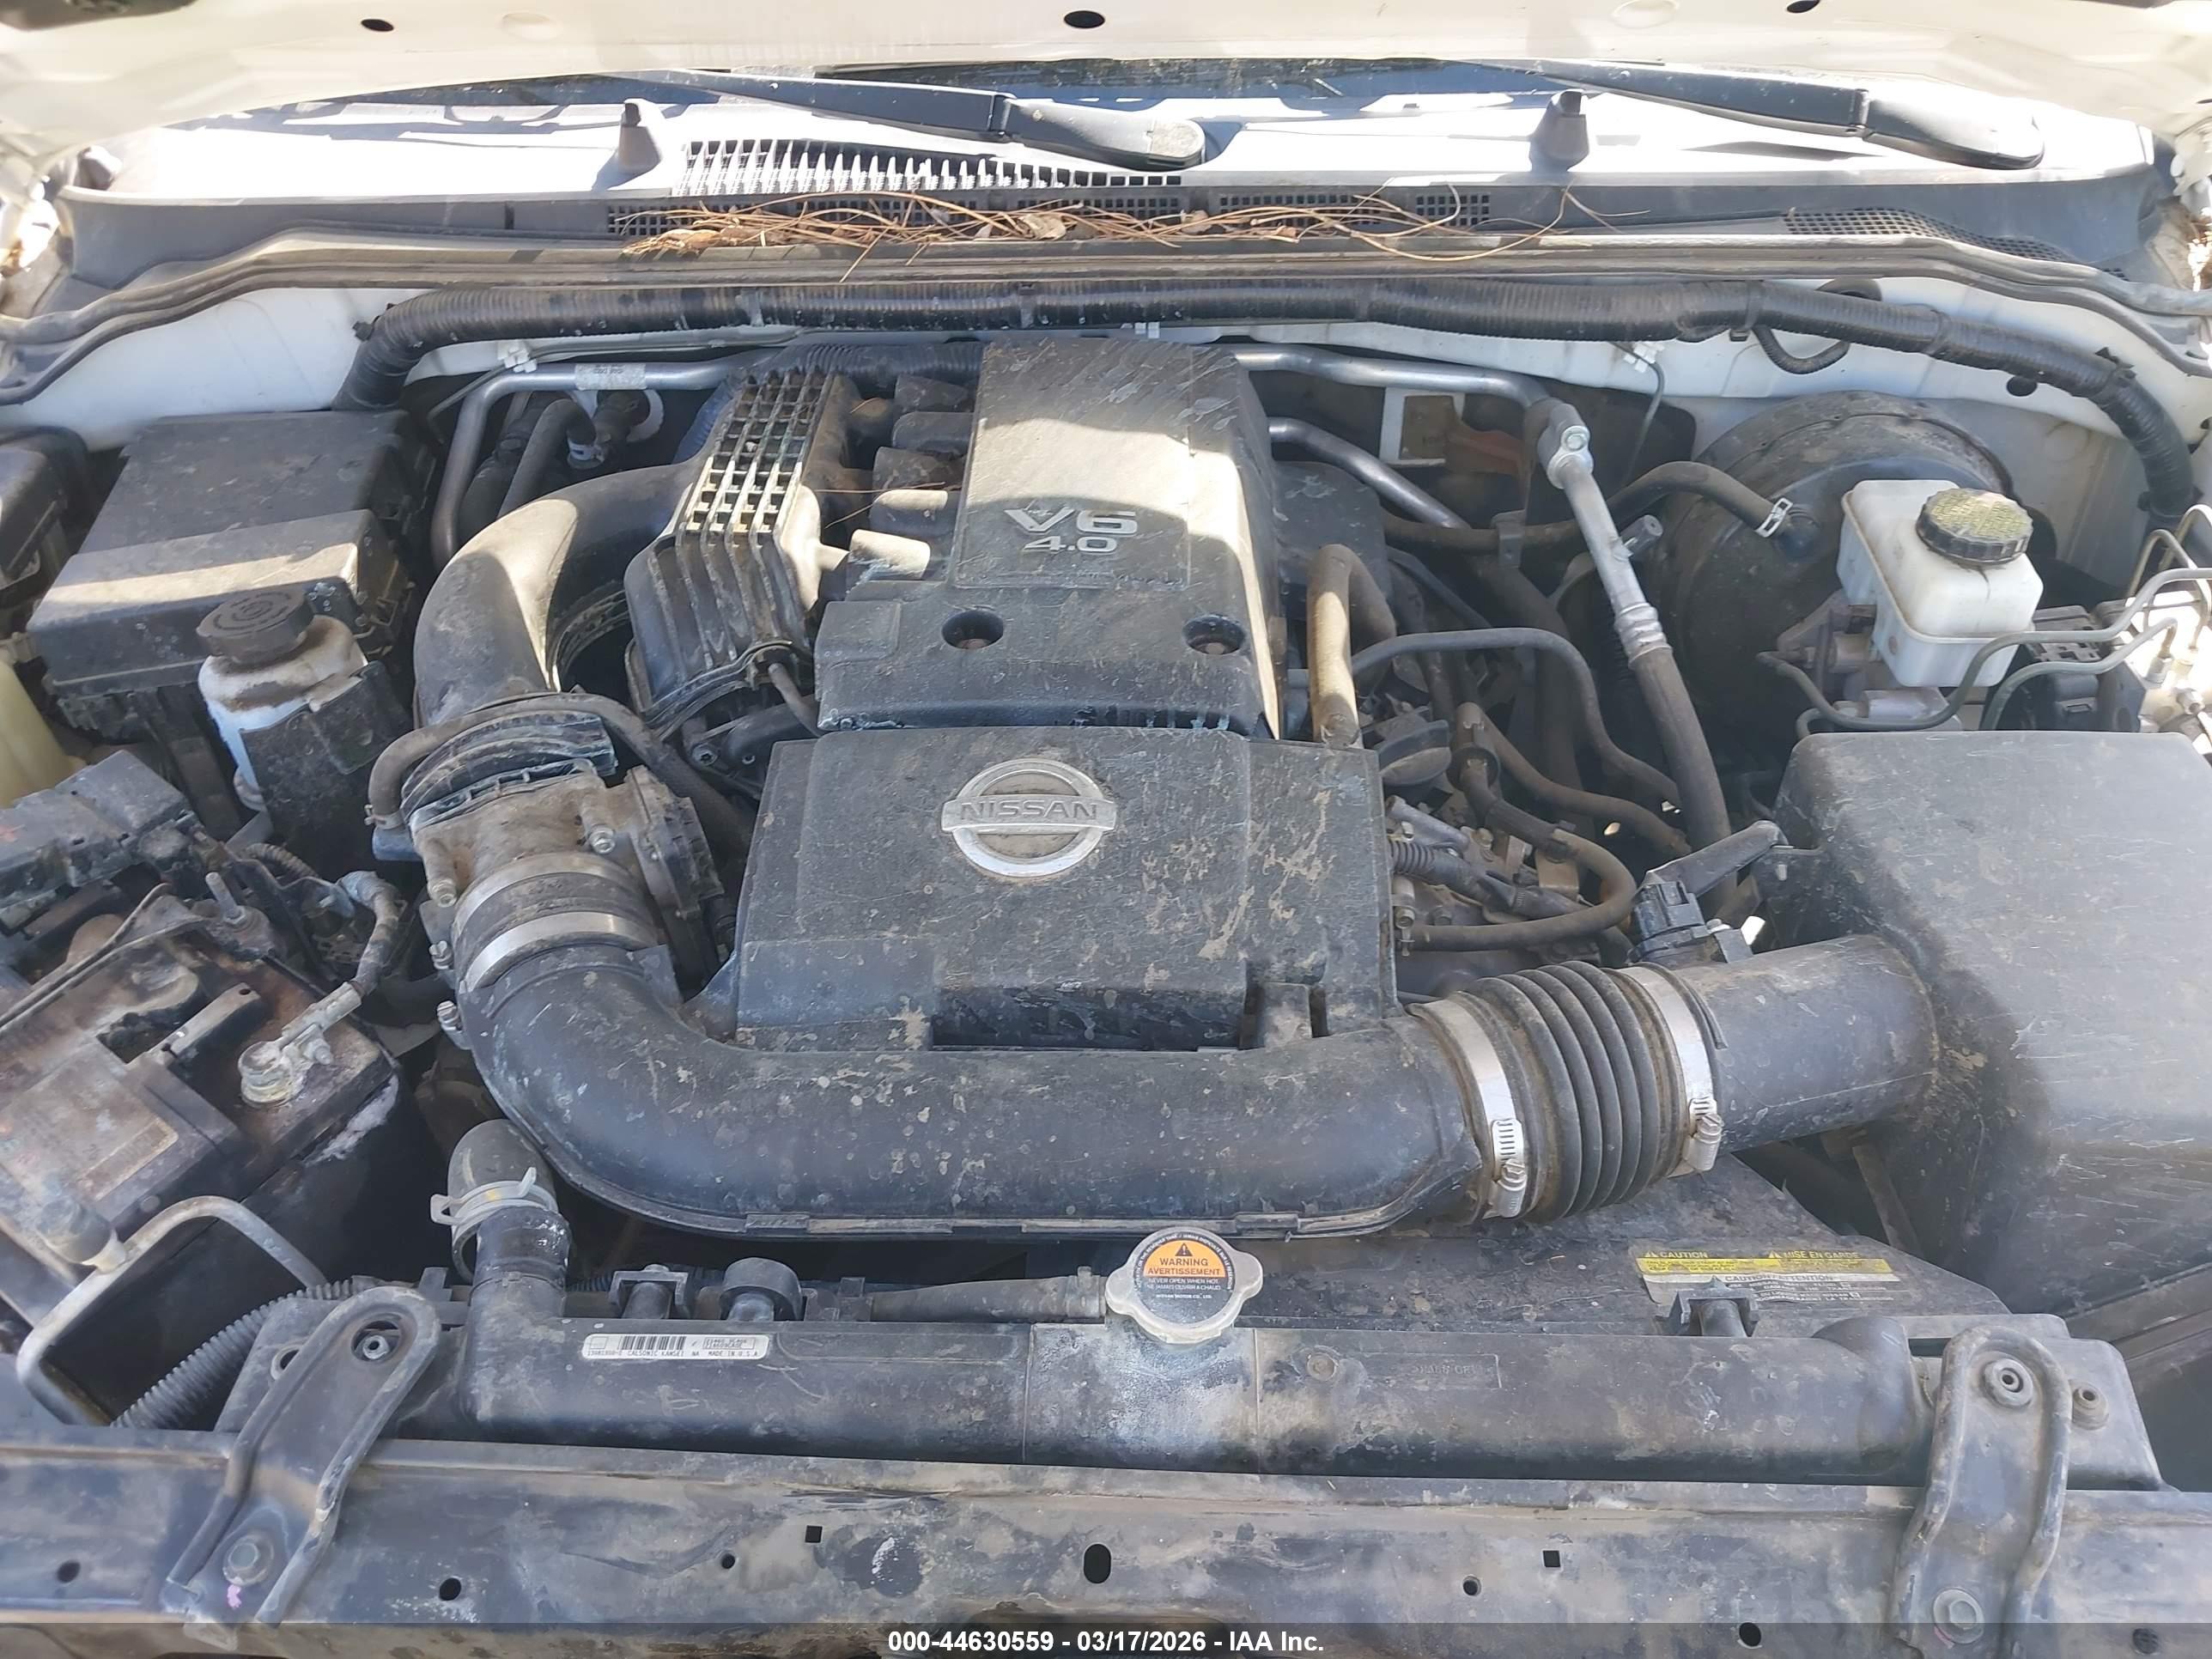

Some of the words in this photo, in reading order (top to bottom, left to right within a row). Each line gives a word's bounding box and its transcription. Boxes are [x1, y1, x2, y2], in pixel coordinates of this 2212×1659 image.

[1003, 506, 1139, 535] V6
[1023, 536, 1117, 555] 4.0
[960, 800, 1098, 820] NISSAN
[1784, 1250, 1808, 1259] MISE
[1808, 1250, 1823, 1259] EN
[1159, 1257, 1208, 1267] WARNING
[1725, 1273, 1771, 1282] CAUTION
